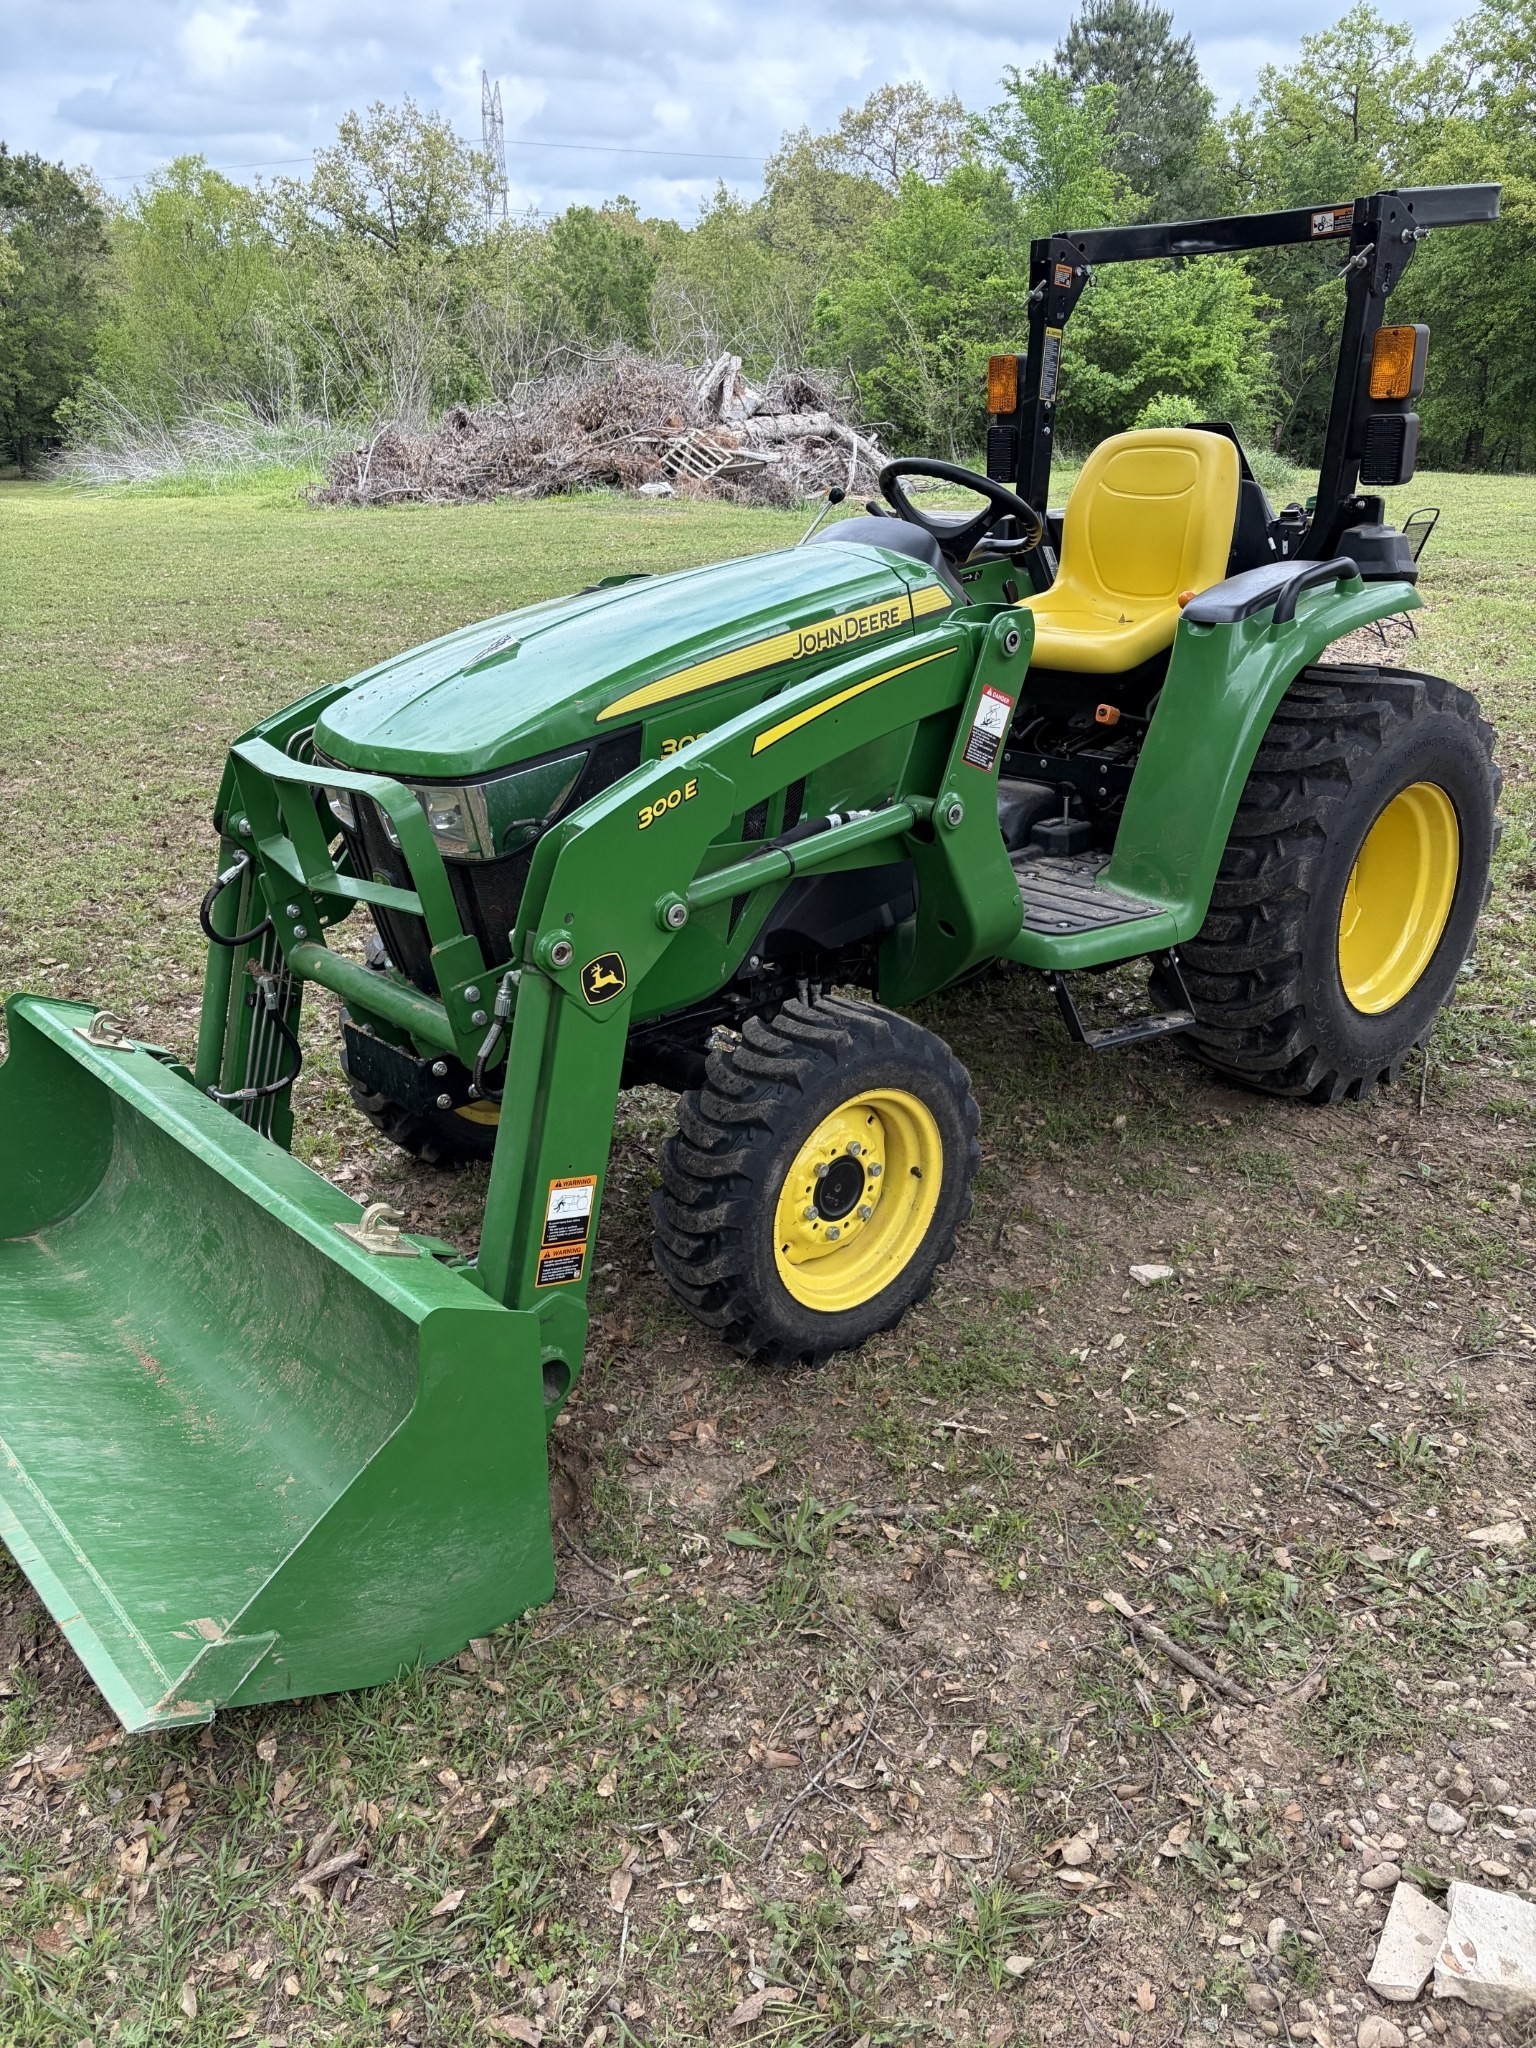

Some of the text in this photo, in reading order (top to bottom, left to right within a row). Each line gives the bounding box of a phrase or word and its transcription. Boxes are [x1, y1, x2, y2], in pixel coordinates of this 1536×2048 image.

[792, 606, 901, 658] JOHN DEERE
[992, 691, 1010, 704] DANGER
[660, 732, 709, 761] 30
[562, 1178, 592, 1187] WARNING
[552, 1247, 582, 1256] WARNING
